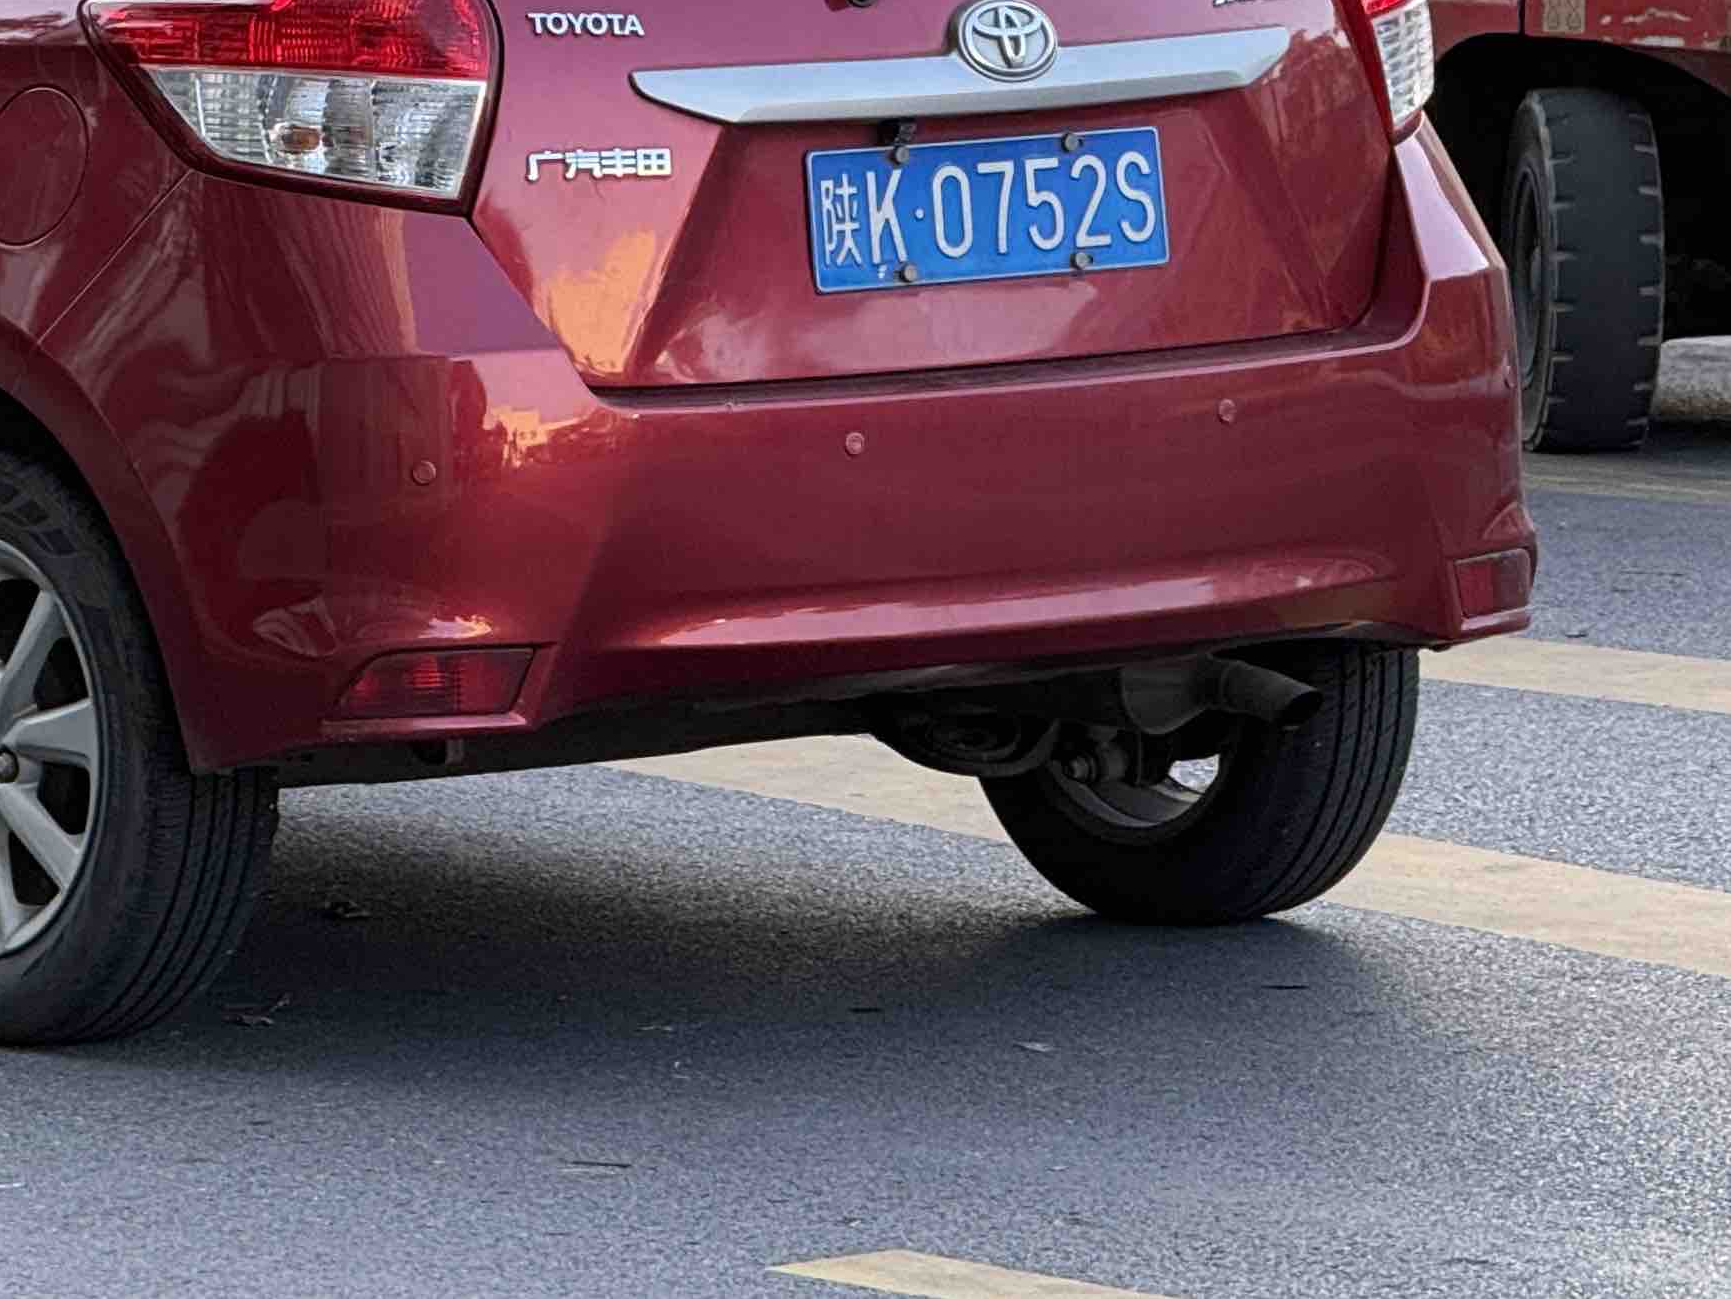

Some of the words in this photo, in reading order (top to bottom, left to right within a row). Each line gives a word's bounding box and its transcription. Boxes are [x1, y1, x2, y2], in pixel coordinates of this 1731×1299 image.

[526, 12, 646, 36] TOYOTA
[526, 148, 672, 182] 广汽丰田
